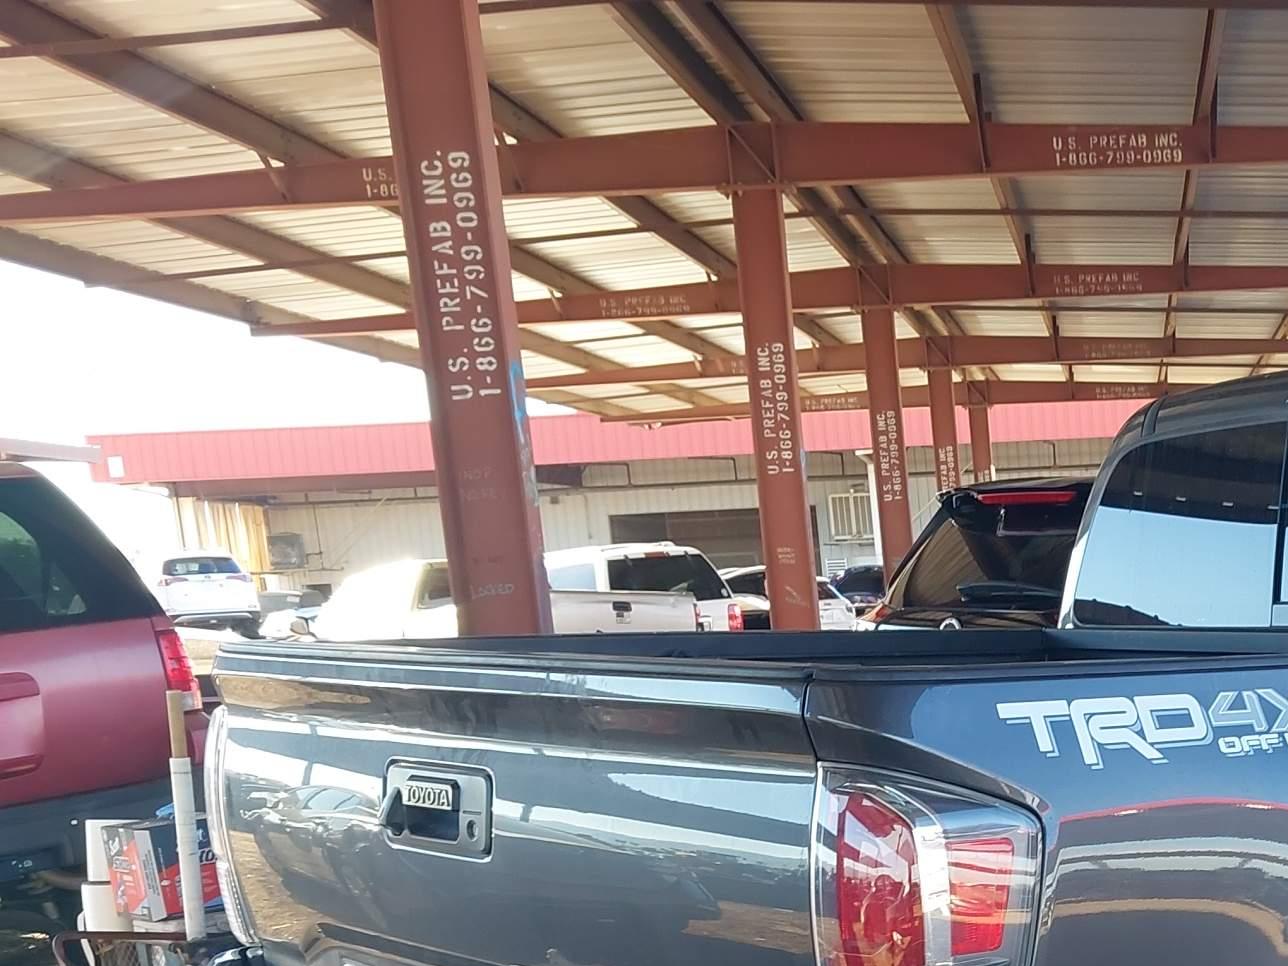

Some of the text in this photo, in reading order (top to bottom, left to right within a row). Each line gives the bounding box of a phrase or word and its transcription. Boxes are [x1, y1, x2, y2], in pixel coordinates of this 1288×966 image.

[1052, 132, 1183, 151] U.S. PREFAB INC.
[1055, 149, 1183, 167] 1-866-799-0969
[420, 150, 474, 401] U.S. PREFAB INC.
[448, 150, 502, 398] 1-866-799-0969
[757, 342, 780, 475] U.S. PREFAB INC.
[771, 342, 795, 473] 1-866-799-0969
[878, 435, 891, 476] PREFAB
[996, 693, 1214, 770] TRD
[1217, 731, 1285, 758] OFF
[405, 784, 451, 807] TOYOTA
